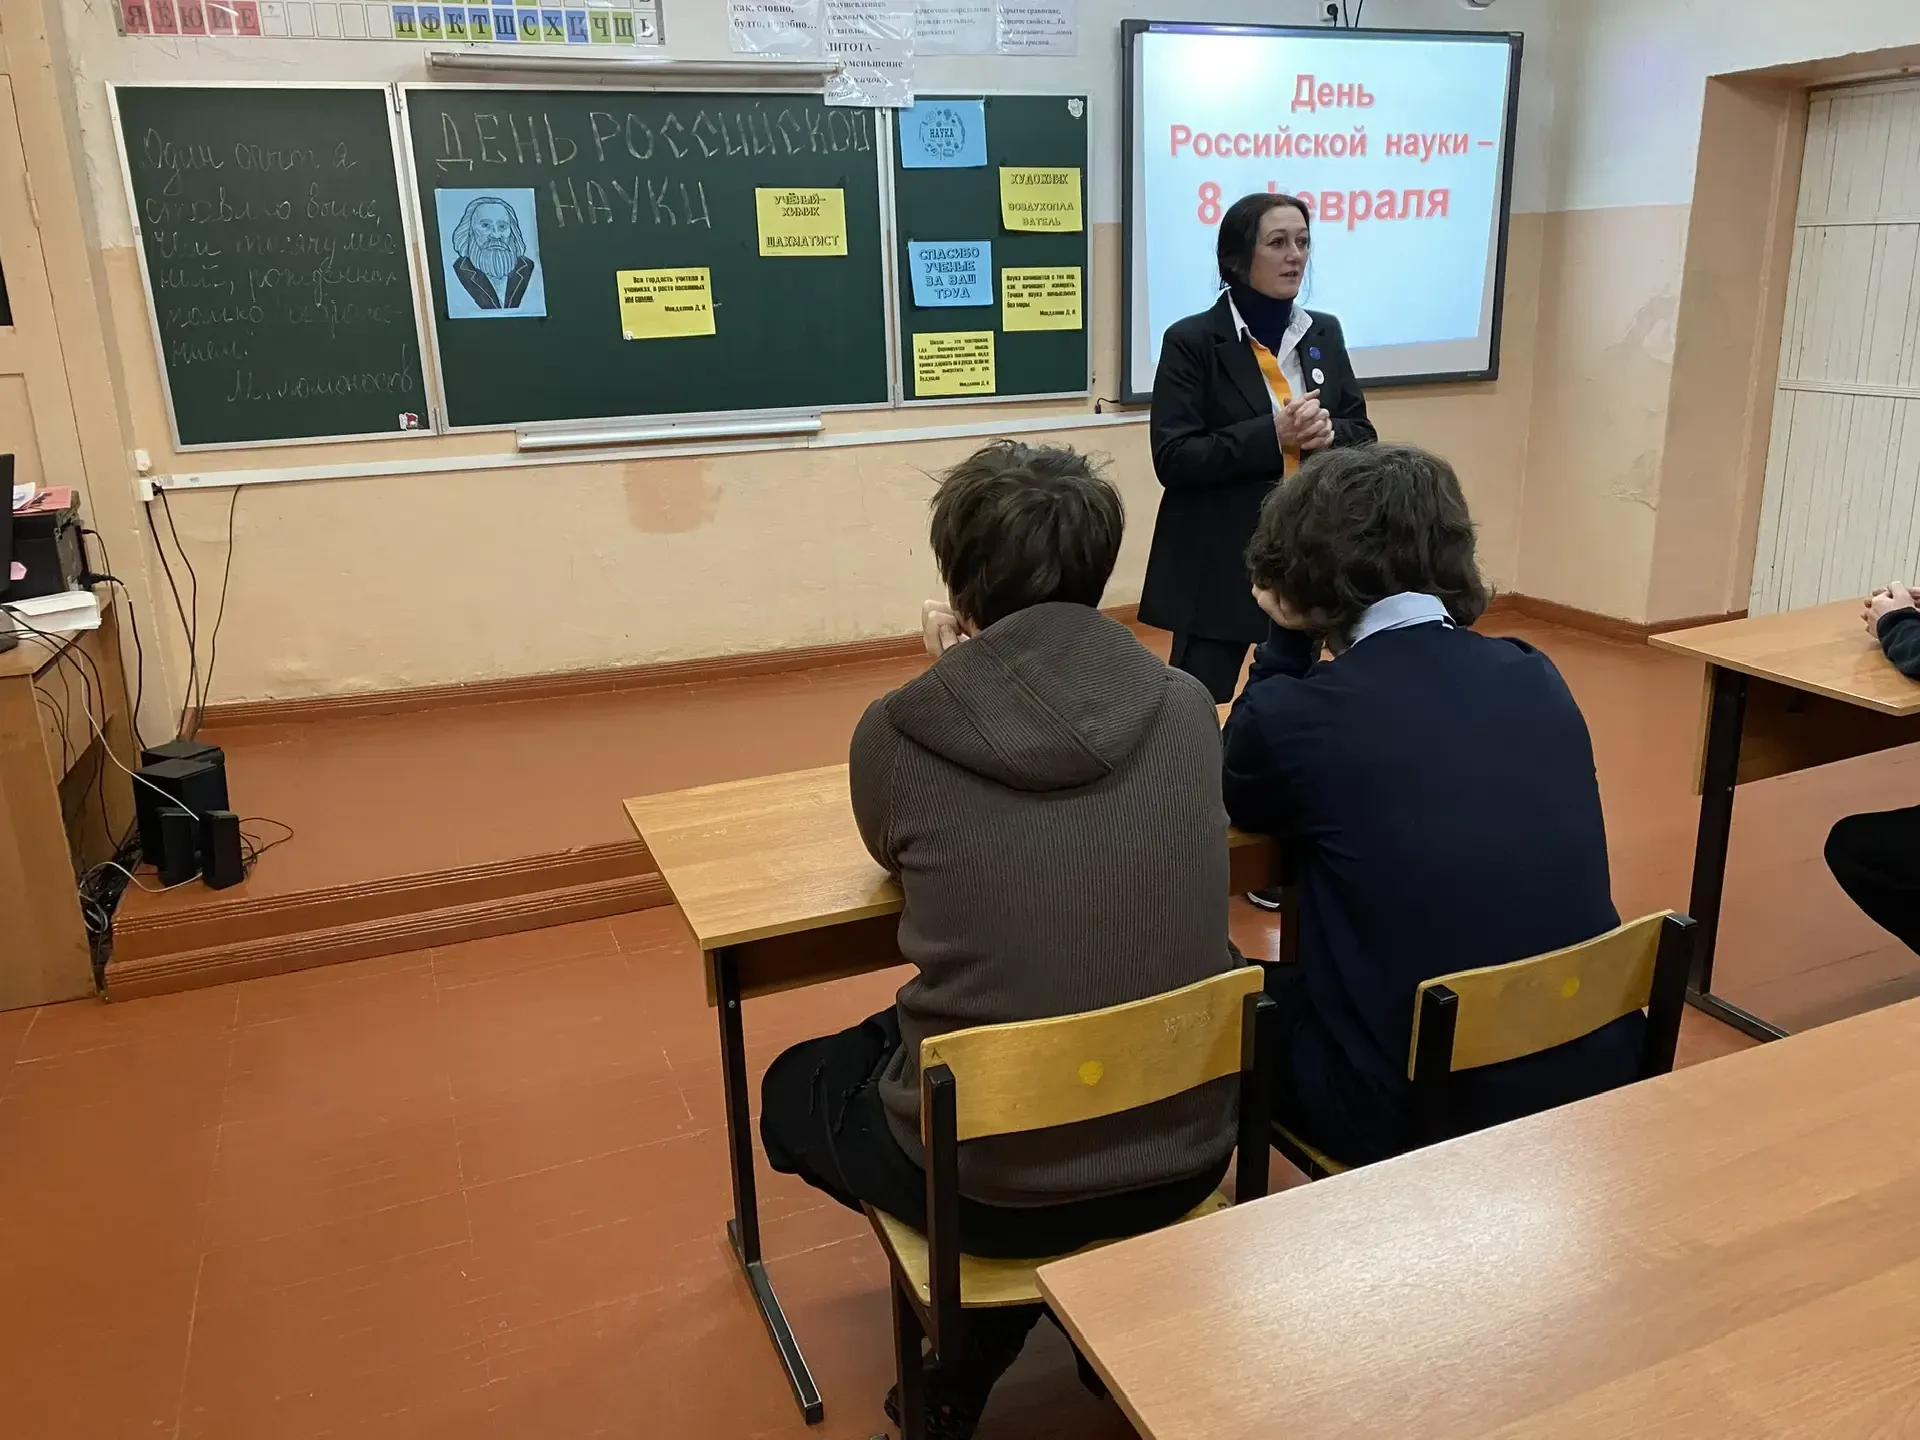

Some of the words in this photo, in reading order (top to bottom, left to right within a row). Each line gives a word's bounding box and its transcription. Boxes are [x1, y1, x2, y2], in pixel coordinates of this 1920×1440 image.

[756, 4, 794, 14] словно,
[734, 18, 765, 30] будто,
[825, 42, 873, 52] ЛИТОТА
[843, 60, 904, 69] уменьшение
[1290, 73, 1375, 113] День
[436, 111, 578, 172] ДЕНЬ
[589, 102, 871, 160] РОССИЙСКОЙ
[929, 127, 955, 139] НАУКА
[1169, 123, 1367, 158] Российской
[1384, 131, 1469, 163] науки
[549, 175, 712, 229] НАУКИ
[1007, 201, 1075, 212] ВОЗДУХОПЛА
[1196, 181, 1222, 226] 8
[1266, 180, 1451, 231] евраля
[782, 206, 821, 217] ХИМИК
[1022, 216, 1061, 227] ВАТЕЛЬ
[766, 235, 840, 248] ШАХМАТИСТ
[918, 246, 980, 261] СПАСИБО
[925, 260, 976, 273] УЧЕНЫЕ
[632, 276, 644, 284] Вся
[645, 276, 674, 284] гордость
[675, 275, 699, 283] учителя
[925, 275, 944, 287] ЗА
[948, 273, 977, 286] ВАШ
[658, 285, 674, 293] росте
[934, 286, 971, 300] ТРУД
